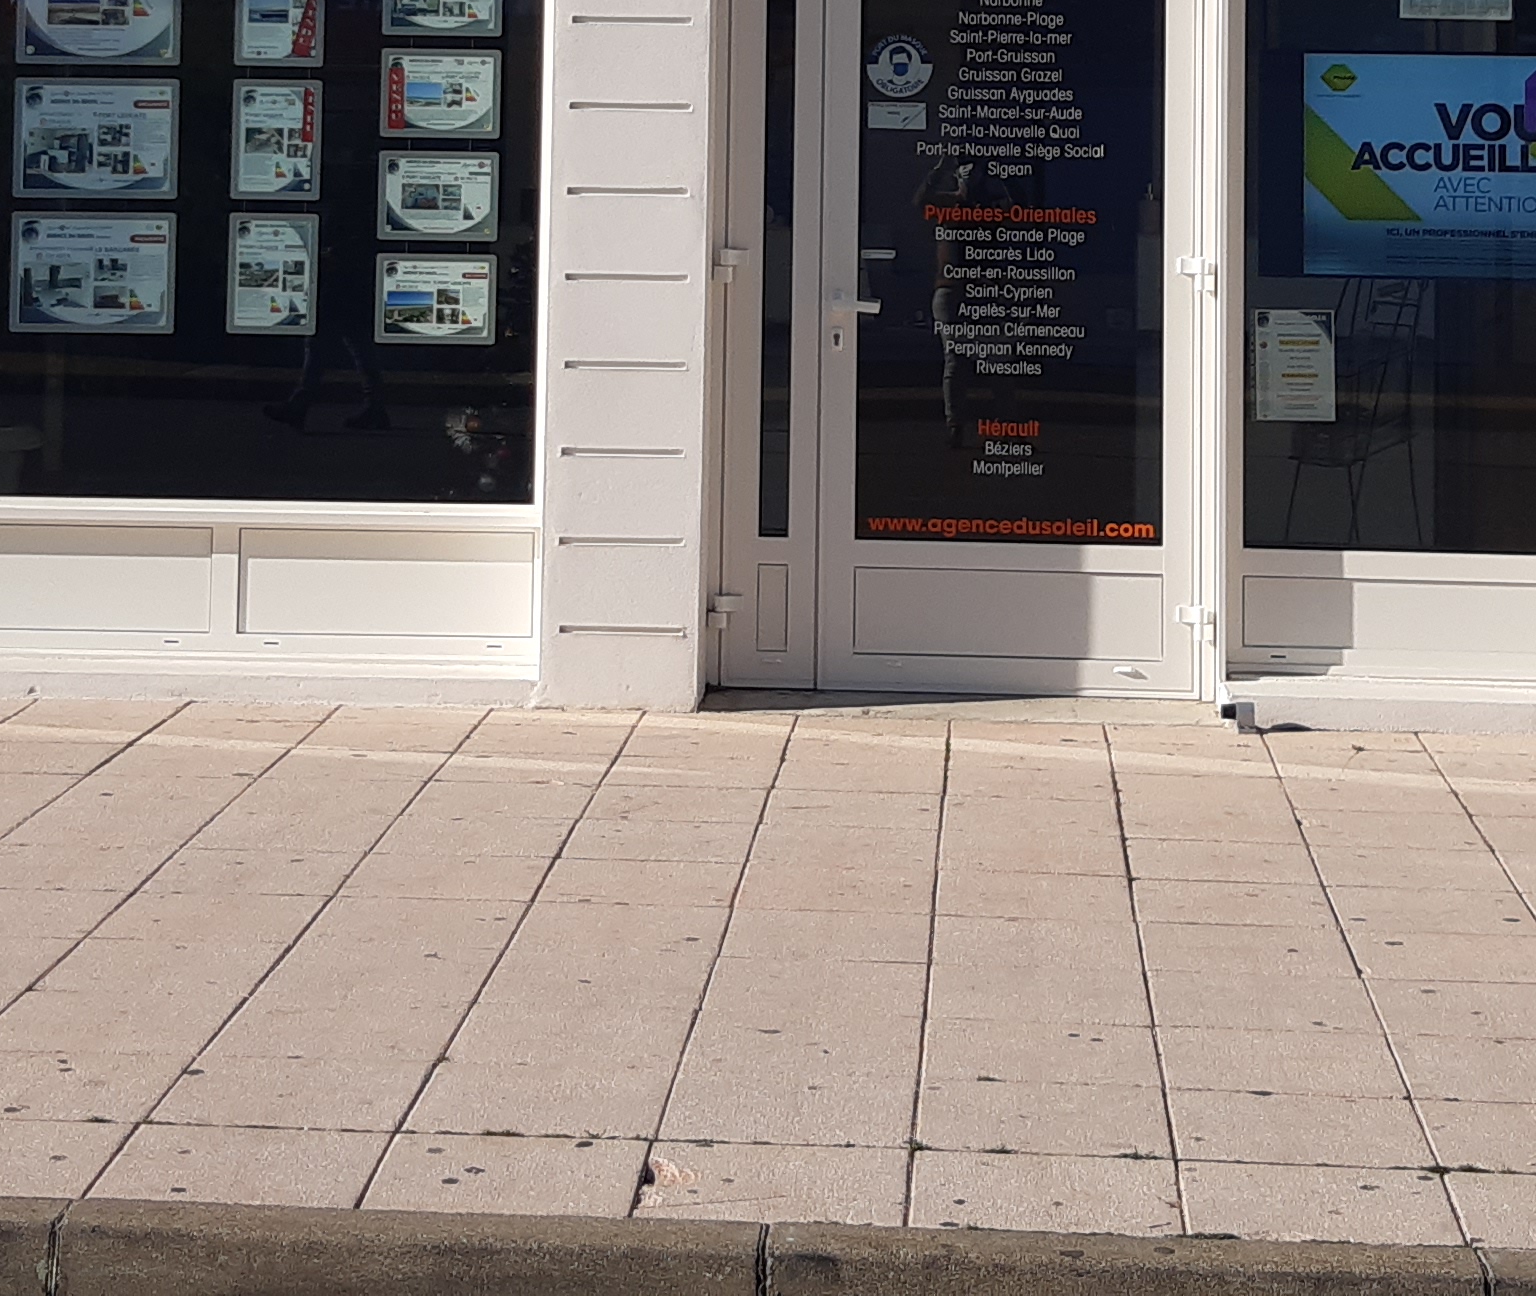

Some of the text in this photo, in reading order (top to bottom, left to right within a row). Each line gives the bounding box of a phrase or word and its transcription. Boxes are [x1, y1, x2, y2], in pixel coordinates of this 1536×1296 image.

[958, 11, 1064, 29] Narbonne-Plage
[949, 27, 1073, 45] Saint-Pierre-la-mer
[966, 48, 1056, 64] Port-Gruissan
[958, 66, 1063, 83] Gruissan Grazel
[947, 85, 1074, 104] Gruissan Ayguades
[938, 104, 1083, 120] Saint-Marcel-sur-Aude
[940, 122, 1080, 139] Port-la-Nouvelle Quai
[916, 141, 1105, 160] Port-la-Nouvelle Siège Social
[987, 161, 1033, 179] Sigean
[1433, 176, 1492, 195] AVEC
[925, 204, 1097, 225] Pyrénées-Orientales
[935, 226, 1085, 246] Barcarès Grande Plage
[965, 245, 1055, 262] Barcarès Lido
[943, 263, 1076, 281] Canet-en-Roussillon
[965, 283, 1053, 302] Saint-Cyprien
[957, 302, 1061, 320] Argelès-sur-Mer
[933, 320, 1085, 339] Perpignan Clémenceau
[943, 340, 1073, 360] Perpignan Kennedy
[976, 359, 1042, 375] Rivesaltes
[978, 419, 1040, 437] Hérault
[985, 440, 1032, 456] Béziers
[973, 460, 1044, 478] Montpellier
[867, 514, 1156, 539] www.agencedusoleil.com
